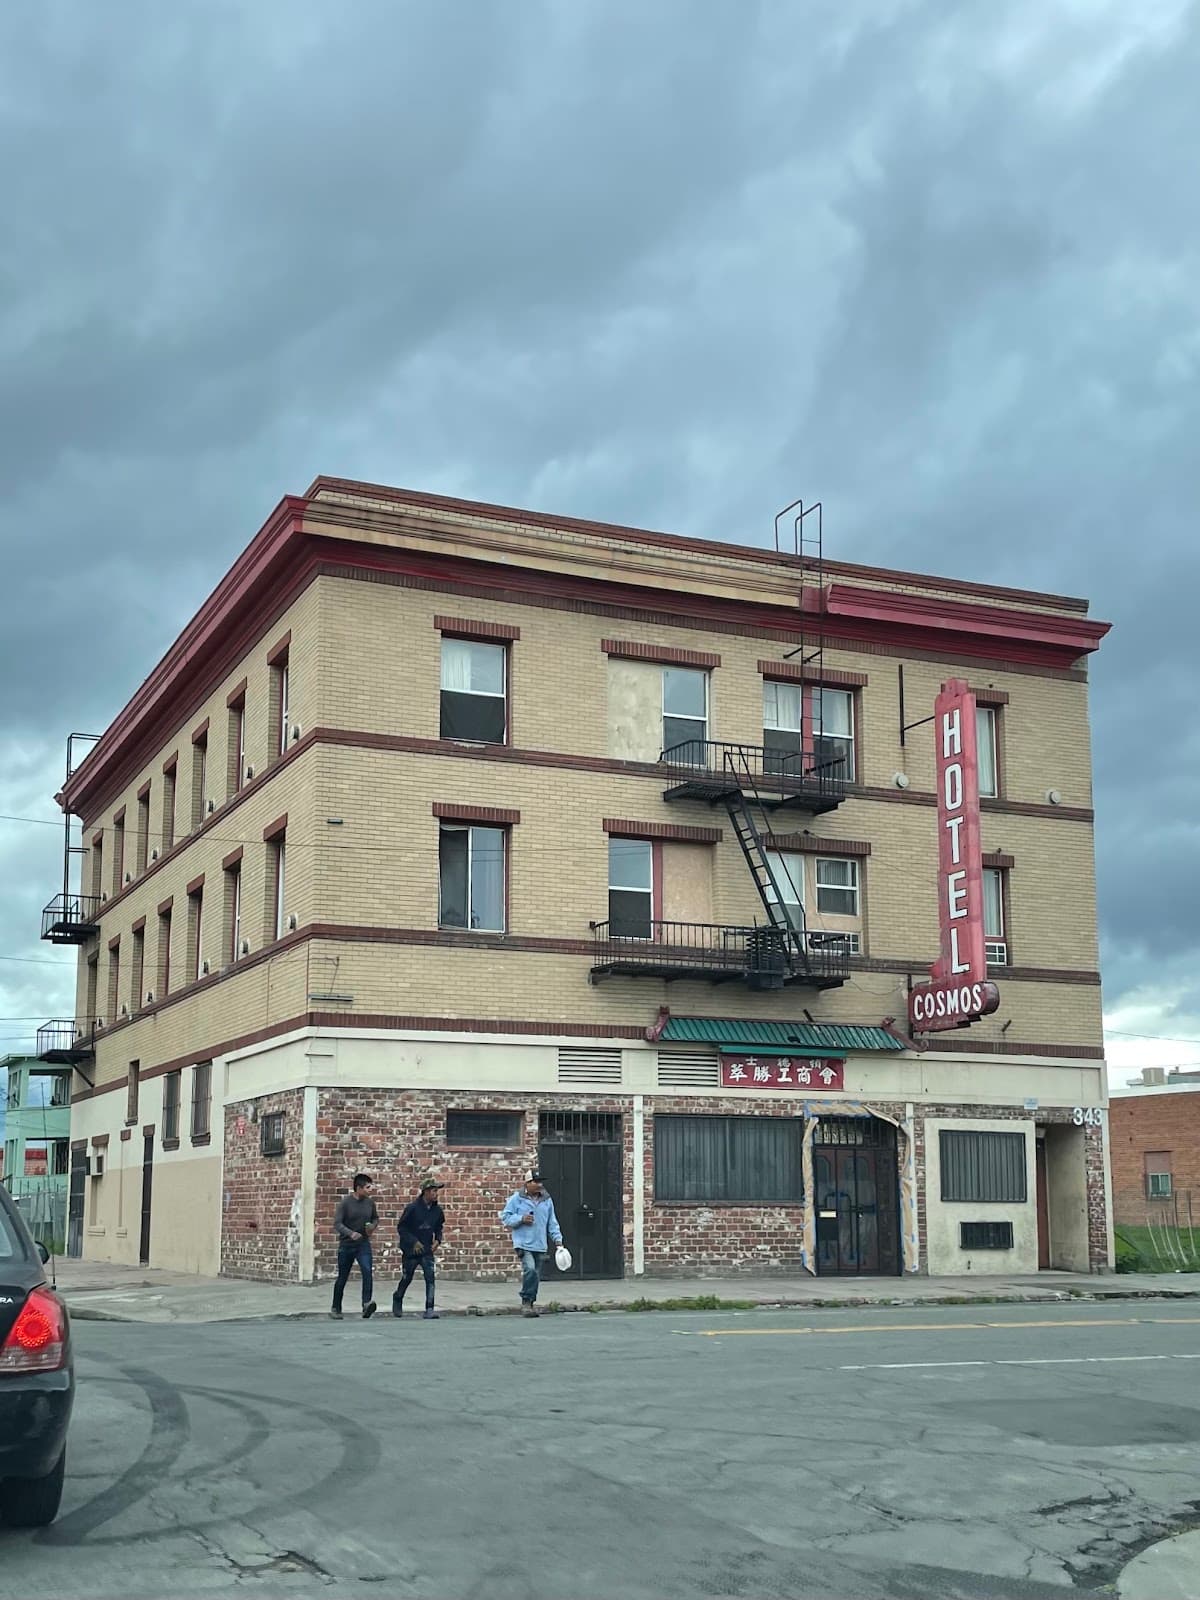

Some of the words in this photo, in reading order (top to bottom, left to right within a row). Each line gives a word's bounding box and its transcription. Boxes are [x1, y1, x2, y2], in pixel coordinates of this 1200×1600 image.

[943, 709, 970, 974] HOTEL
[914, 984, 982, 1020] COSMOS
[729, 1063, 837, 1085] 萃勝工商會
[1073, 1107, 1103, 1126] 343
